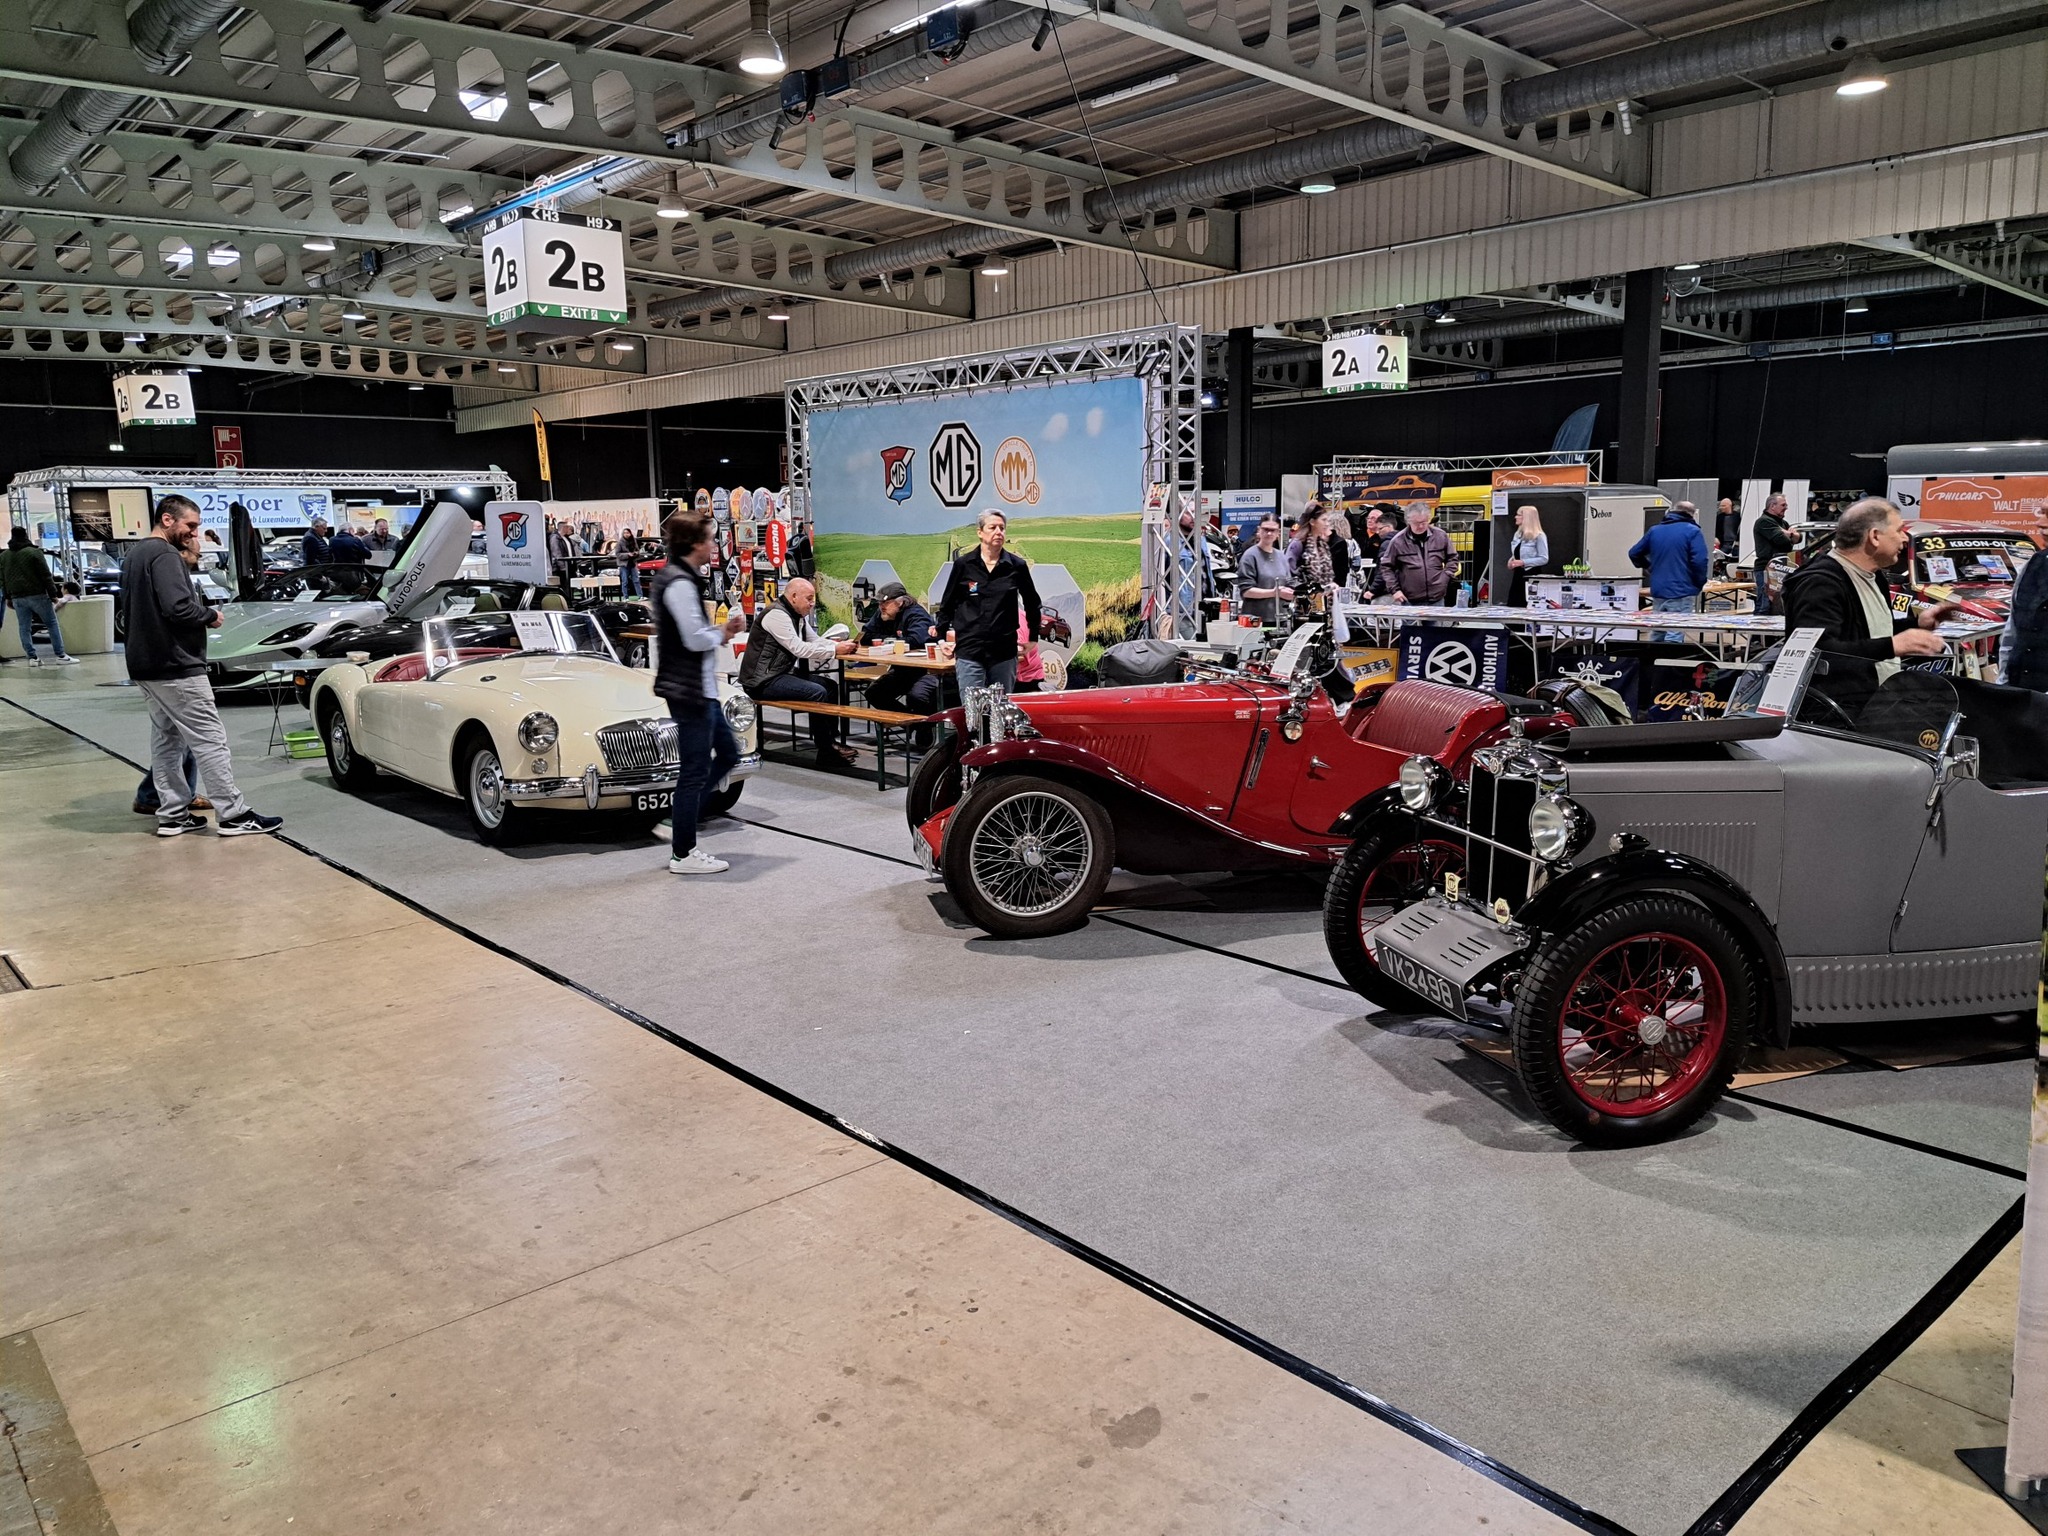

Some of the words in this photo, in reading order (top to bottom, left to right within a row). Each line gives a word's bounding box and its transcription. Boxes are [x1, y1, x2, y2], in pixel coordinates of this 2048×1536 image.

[542, 209, 560, 222] H3
[586, 216, 604, 228] H9
[491, 246, 518, 296] 2B
[544, 239, 606, 293] 2B
[560, 306, 589, 318] EXIT
[1331, 348, 1360, 377] 2A
[1376, 344, 1400, 373] 2A
[141, 384, 181, 410] 2B
[202, 493, 229, 512] 25
[1937, 491, 1984, 501] PHILCARS
[1993, 500, 2020, 511] WALT
[258, 515, 301, 526] Luxembourg
[1590, 506, 1613, 519] Debon
[771, 523, 779, 555] DUCATI
[1921, 537, 1946, 550] 33
[394, 561, 426, 611] AUTOPOLIS
[1893, 595, 1909, 612] 33
[1044, 663, 1057, 675] 30
[1577, 660, 1603, 671] DAF
[1384, 950, 1454, 1009] VK2498
